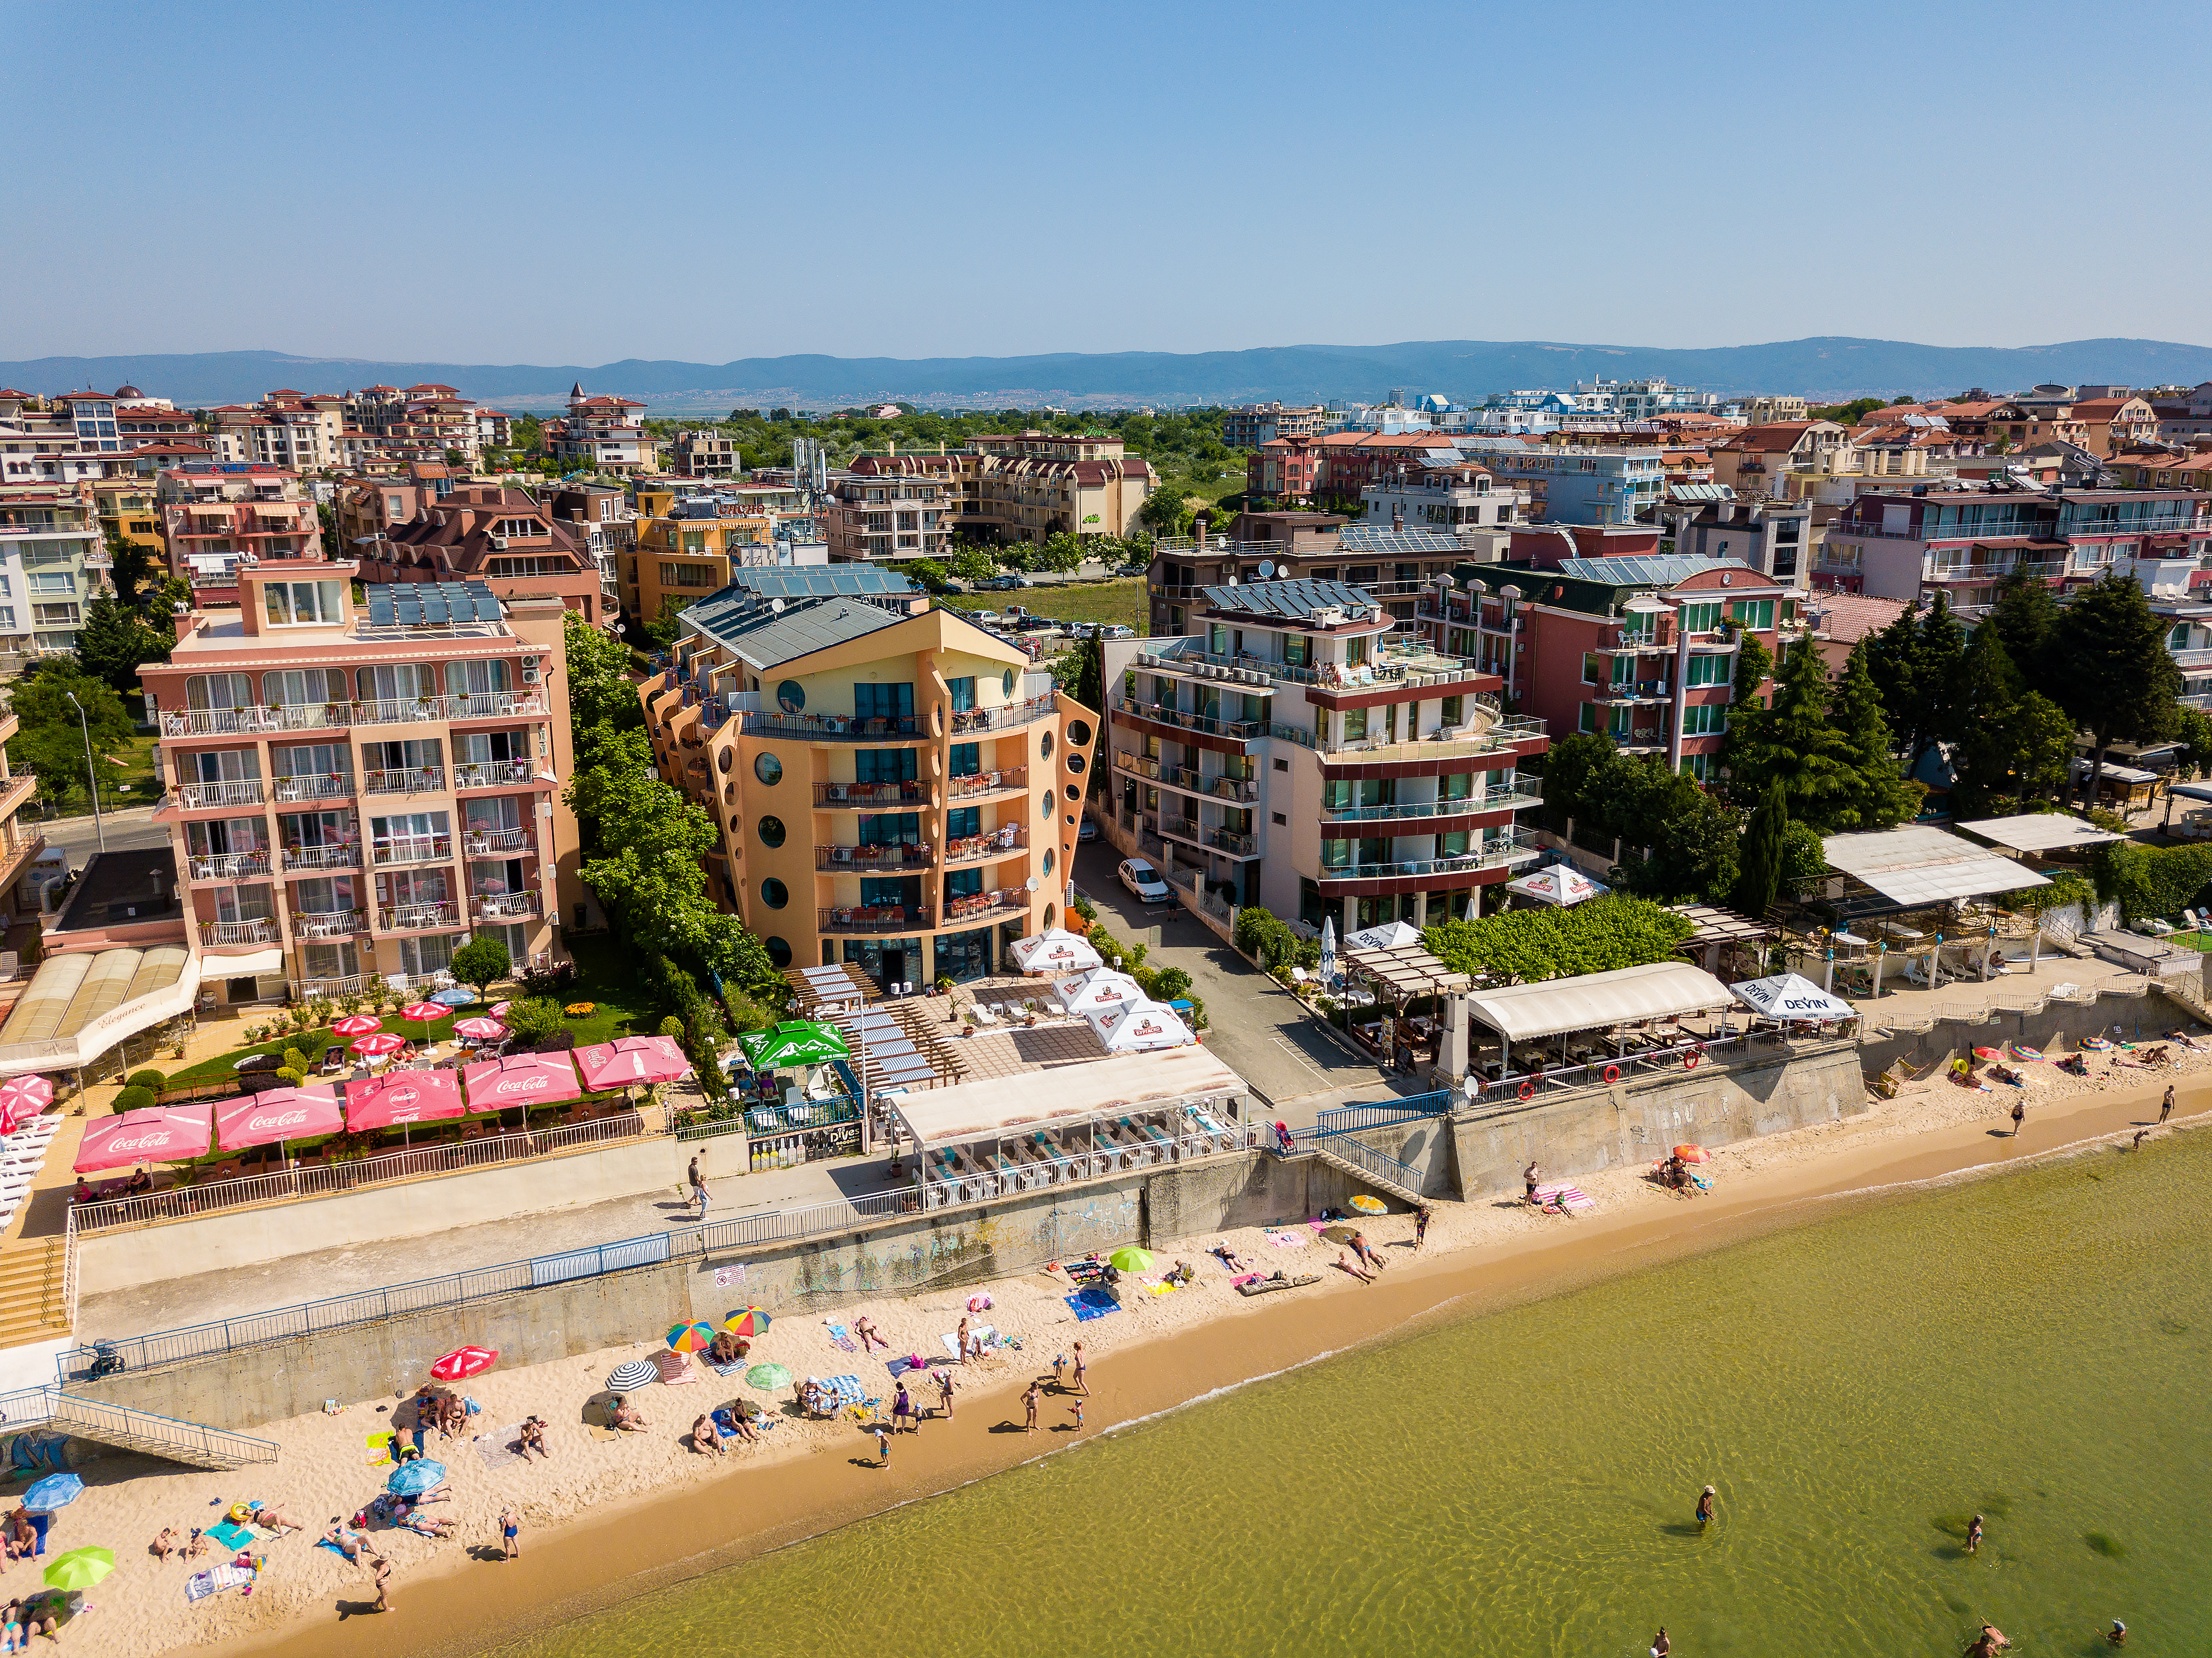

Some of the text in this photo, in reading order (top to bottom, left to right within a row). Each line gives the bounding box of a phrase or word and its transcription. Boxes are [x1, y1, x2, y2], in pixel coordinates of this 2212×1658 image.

[1097, 993, 1121, 1001] БУРГАСКО
[1745, 983, 1773, 1003] DEVIN
[1784, 999, 1829, 1009] DEVIN
[98, 1003, 146, 1029] Elegance
[1136, 1026, 1160, 1036] БУРГАСКО
[496, 1075, 550, 1093] Coca-Cola
[391, 1092, 417, 1102] Coca-Cola
[250, 1108, 310, 1130] Coca-Cola
[393, 1113, 420, 1123] Coca-Cola
[109, 1130, 174, 1152] Coca-Cola
